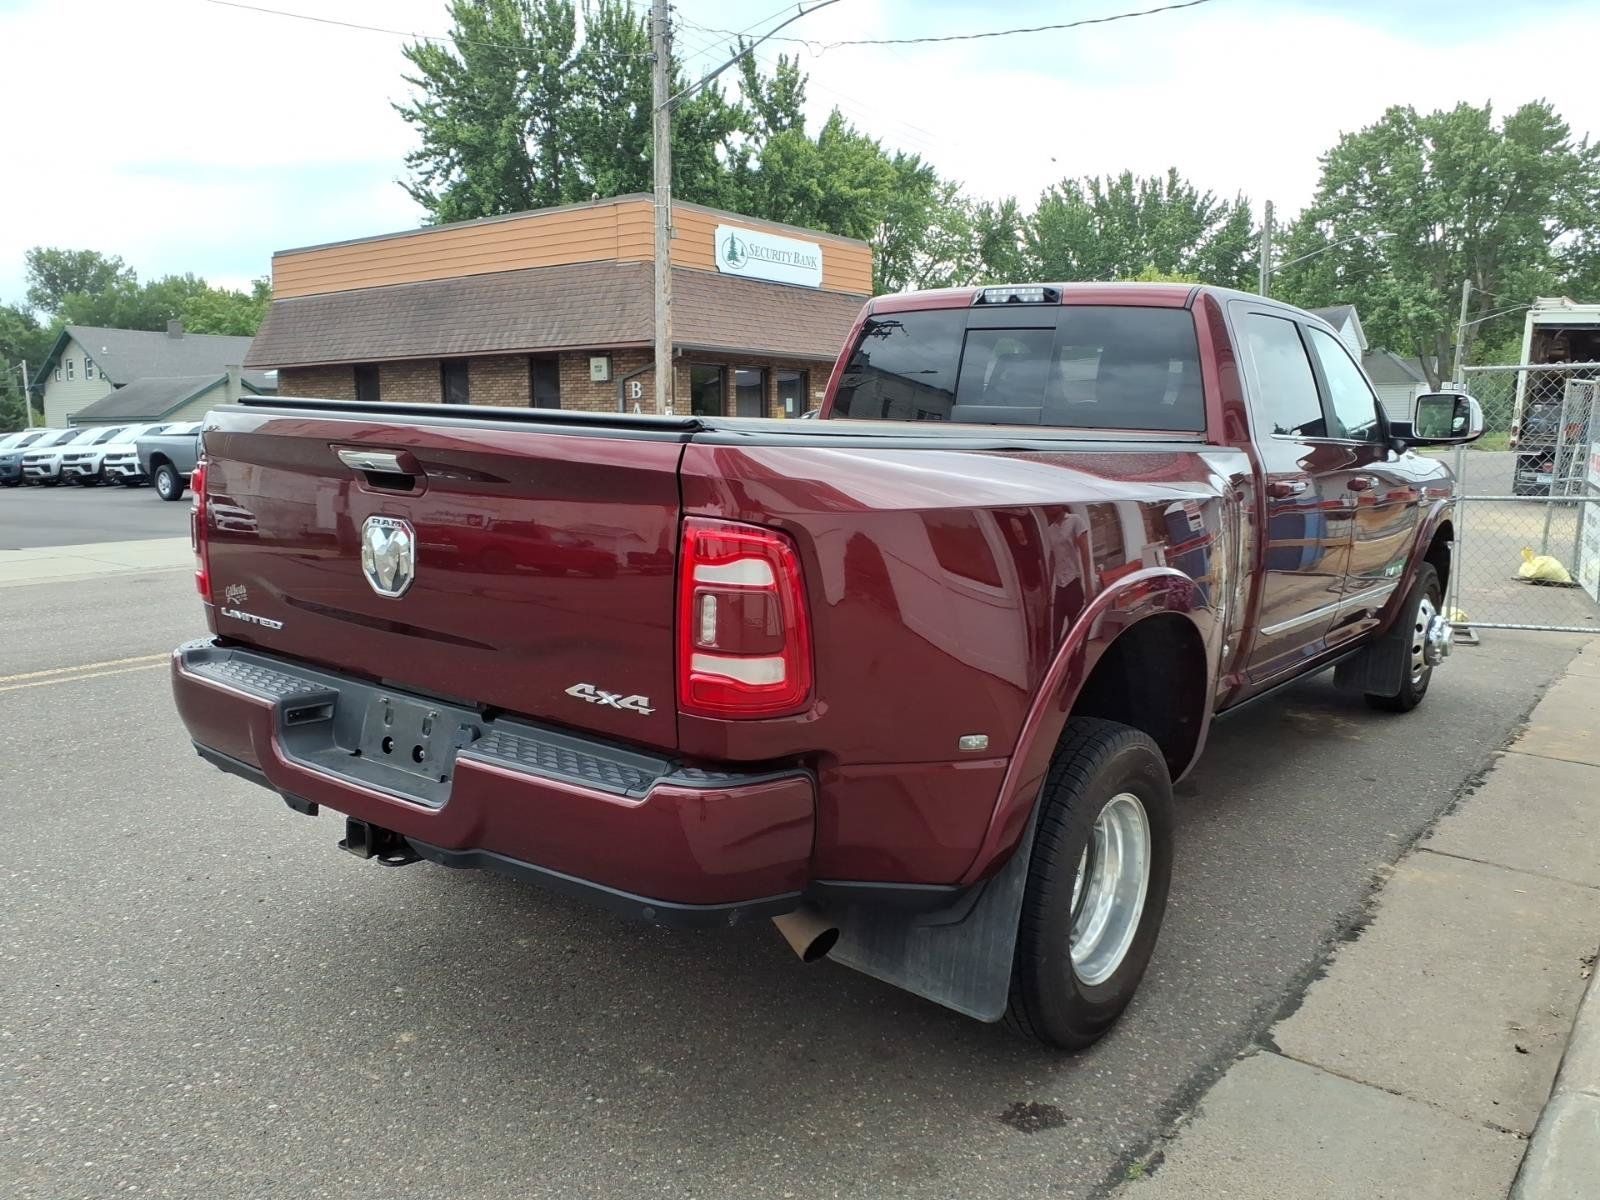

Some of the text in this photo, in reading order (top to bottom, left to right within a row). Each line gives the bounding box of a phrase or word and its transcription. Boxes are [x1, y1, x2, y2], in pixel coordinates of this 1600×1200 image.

[749, 243, 817, 268] SECURITY BANK
[221, 607, 284, 629] LIMITED
